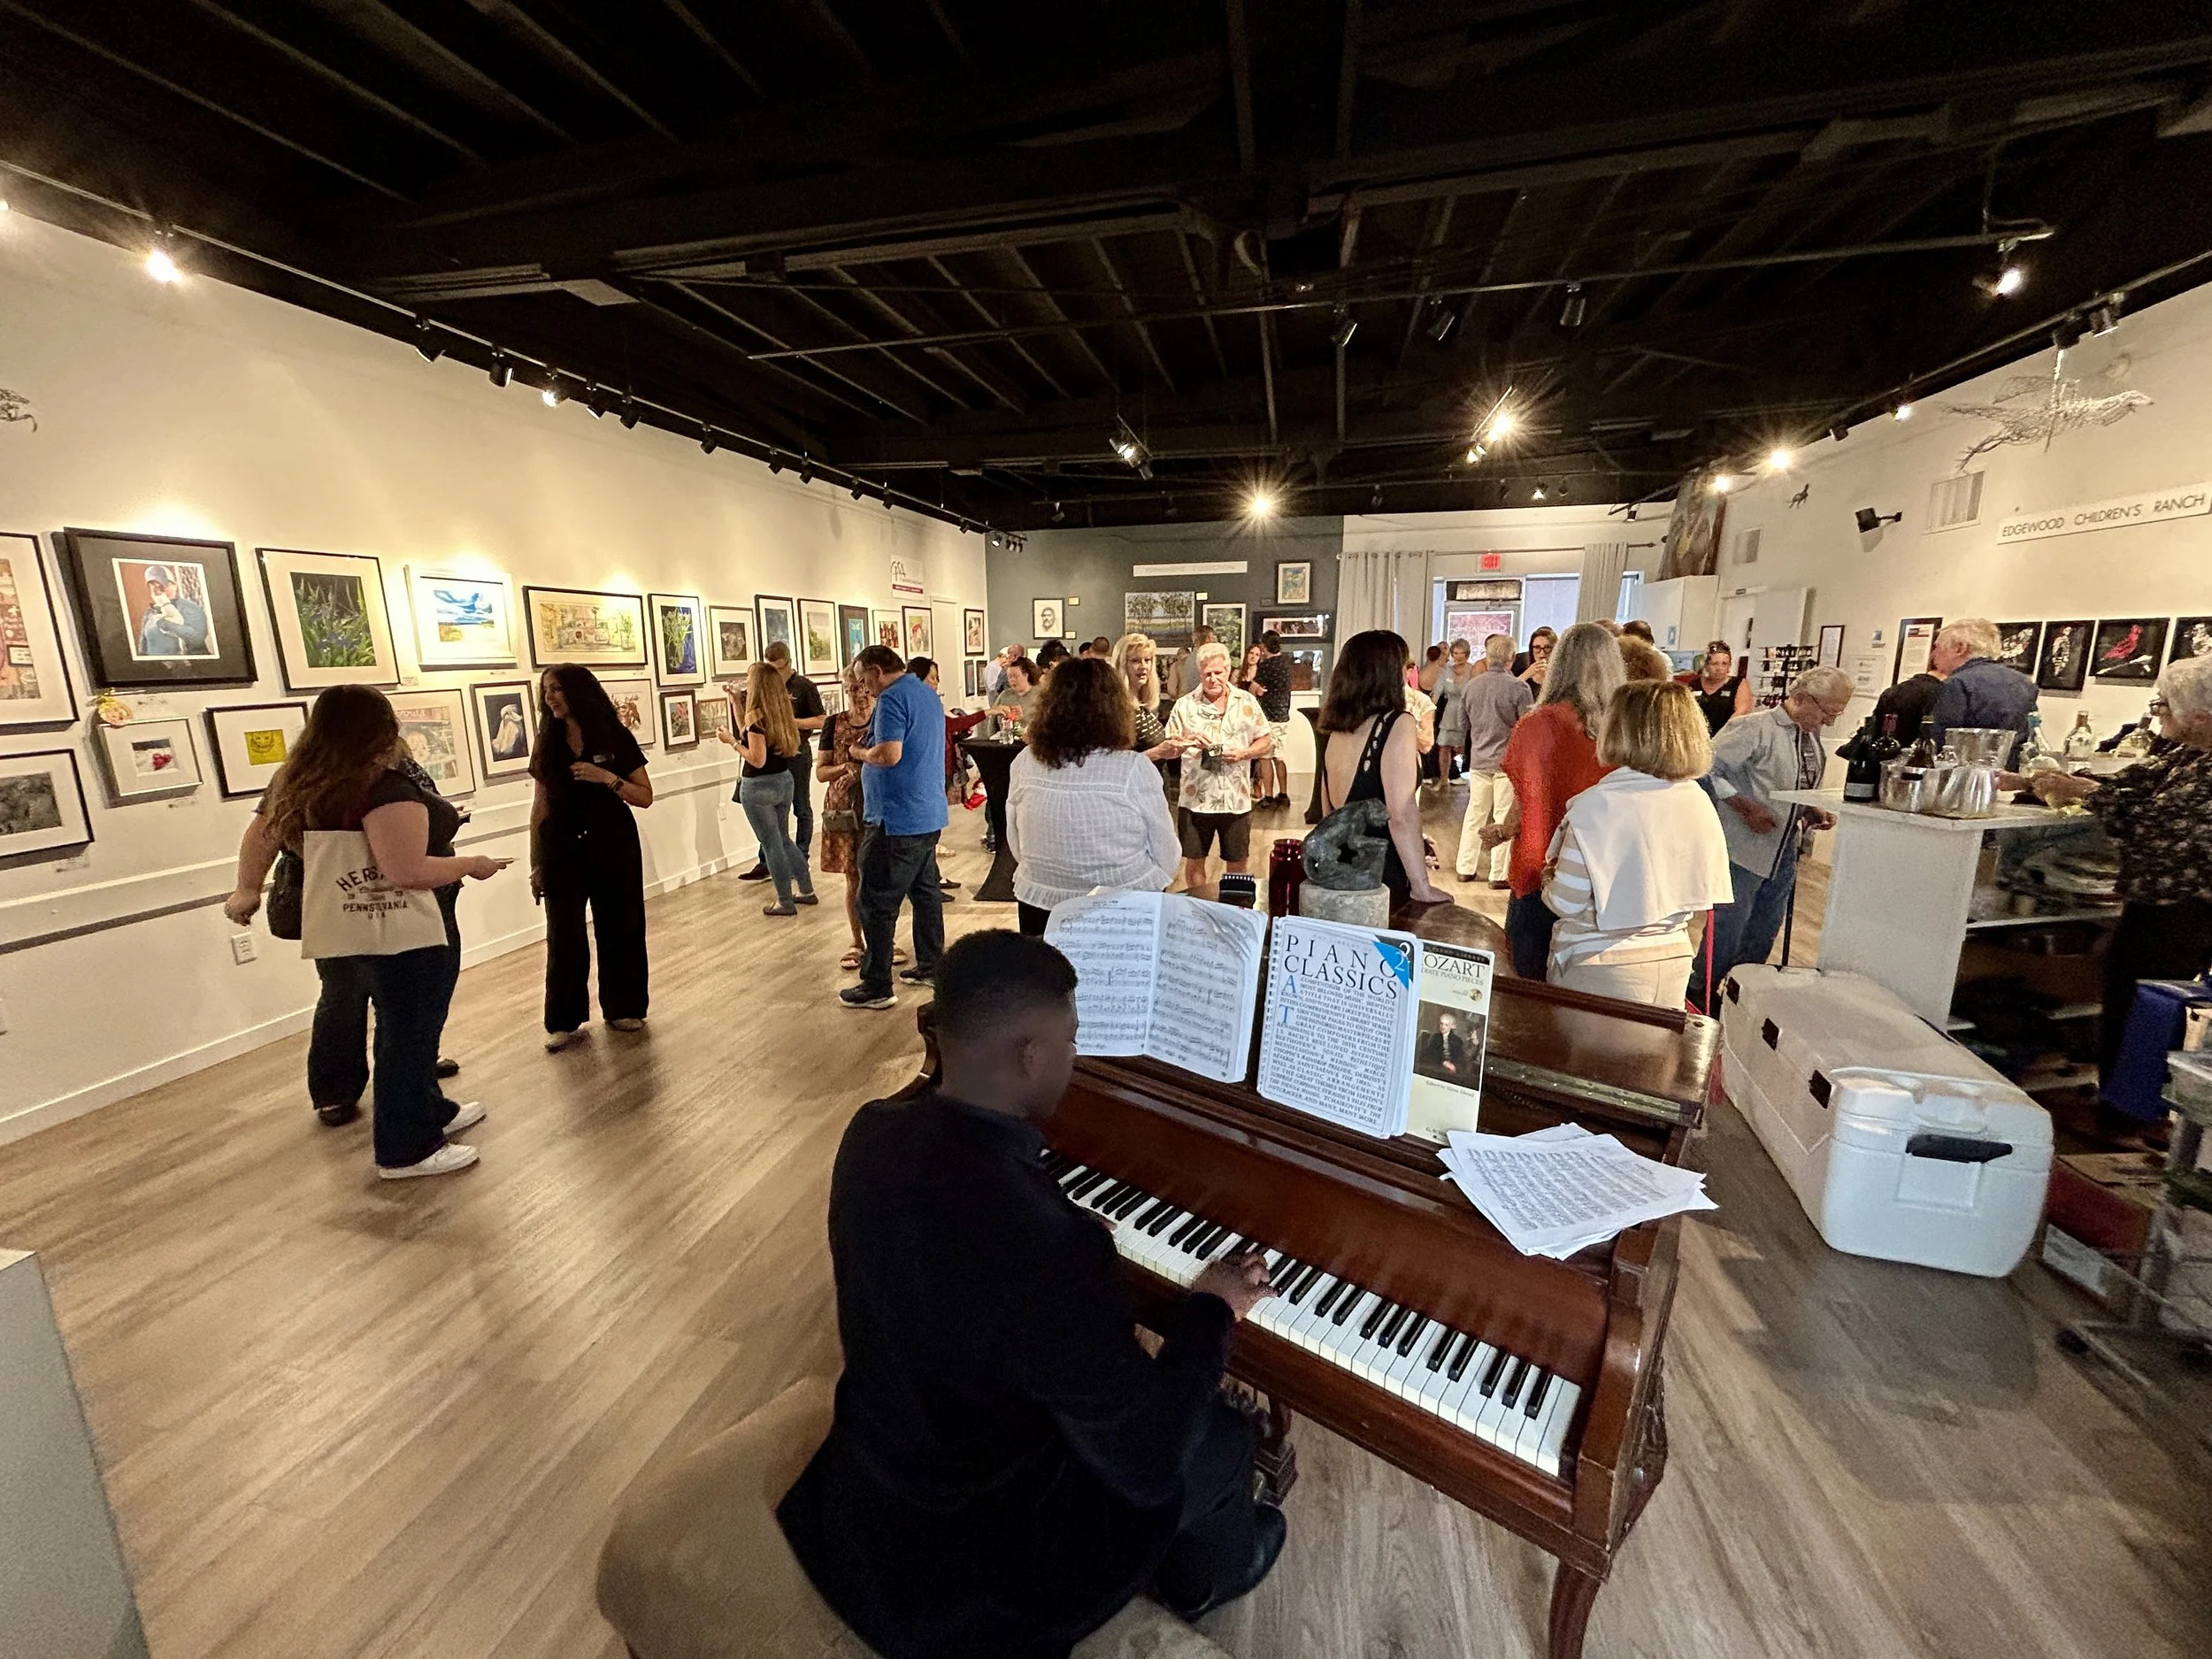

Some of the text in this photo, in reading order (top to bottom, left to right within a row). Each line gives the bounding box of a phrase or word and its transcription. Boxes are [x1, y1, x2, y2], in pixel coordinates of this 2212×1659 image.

[2001, 493, 2206, 537] EDGEWOOD CHILDREN'S RANCH
[1286, 934, 1398, 979] PIANO
[1394, 951, 1406, 972] 2
[1423, 954, 1485, 978] OZART
[1282, 974, 1296, 993] A
[1284, 955, 1397, 1000] CLASSICS
[1279, 1004, 1294, 1023] T
